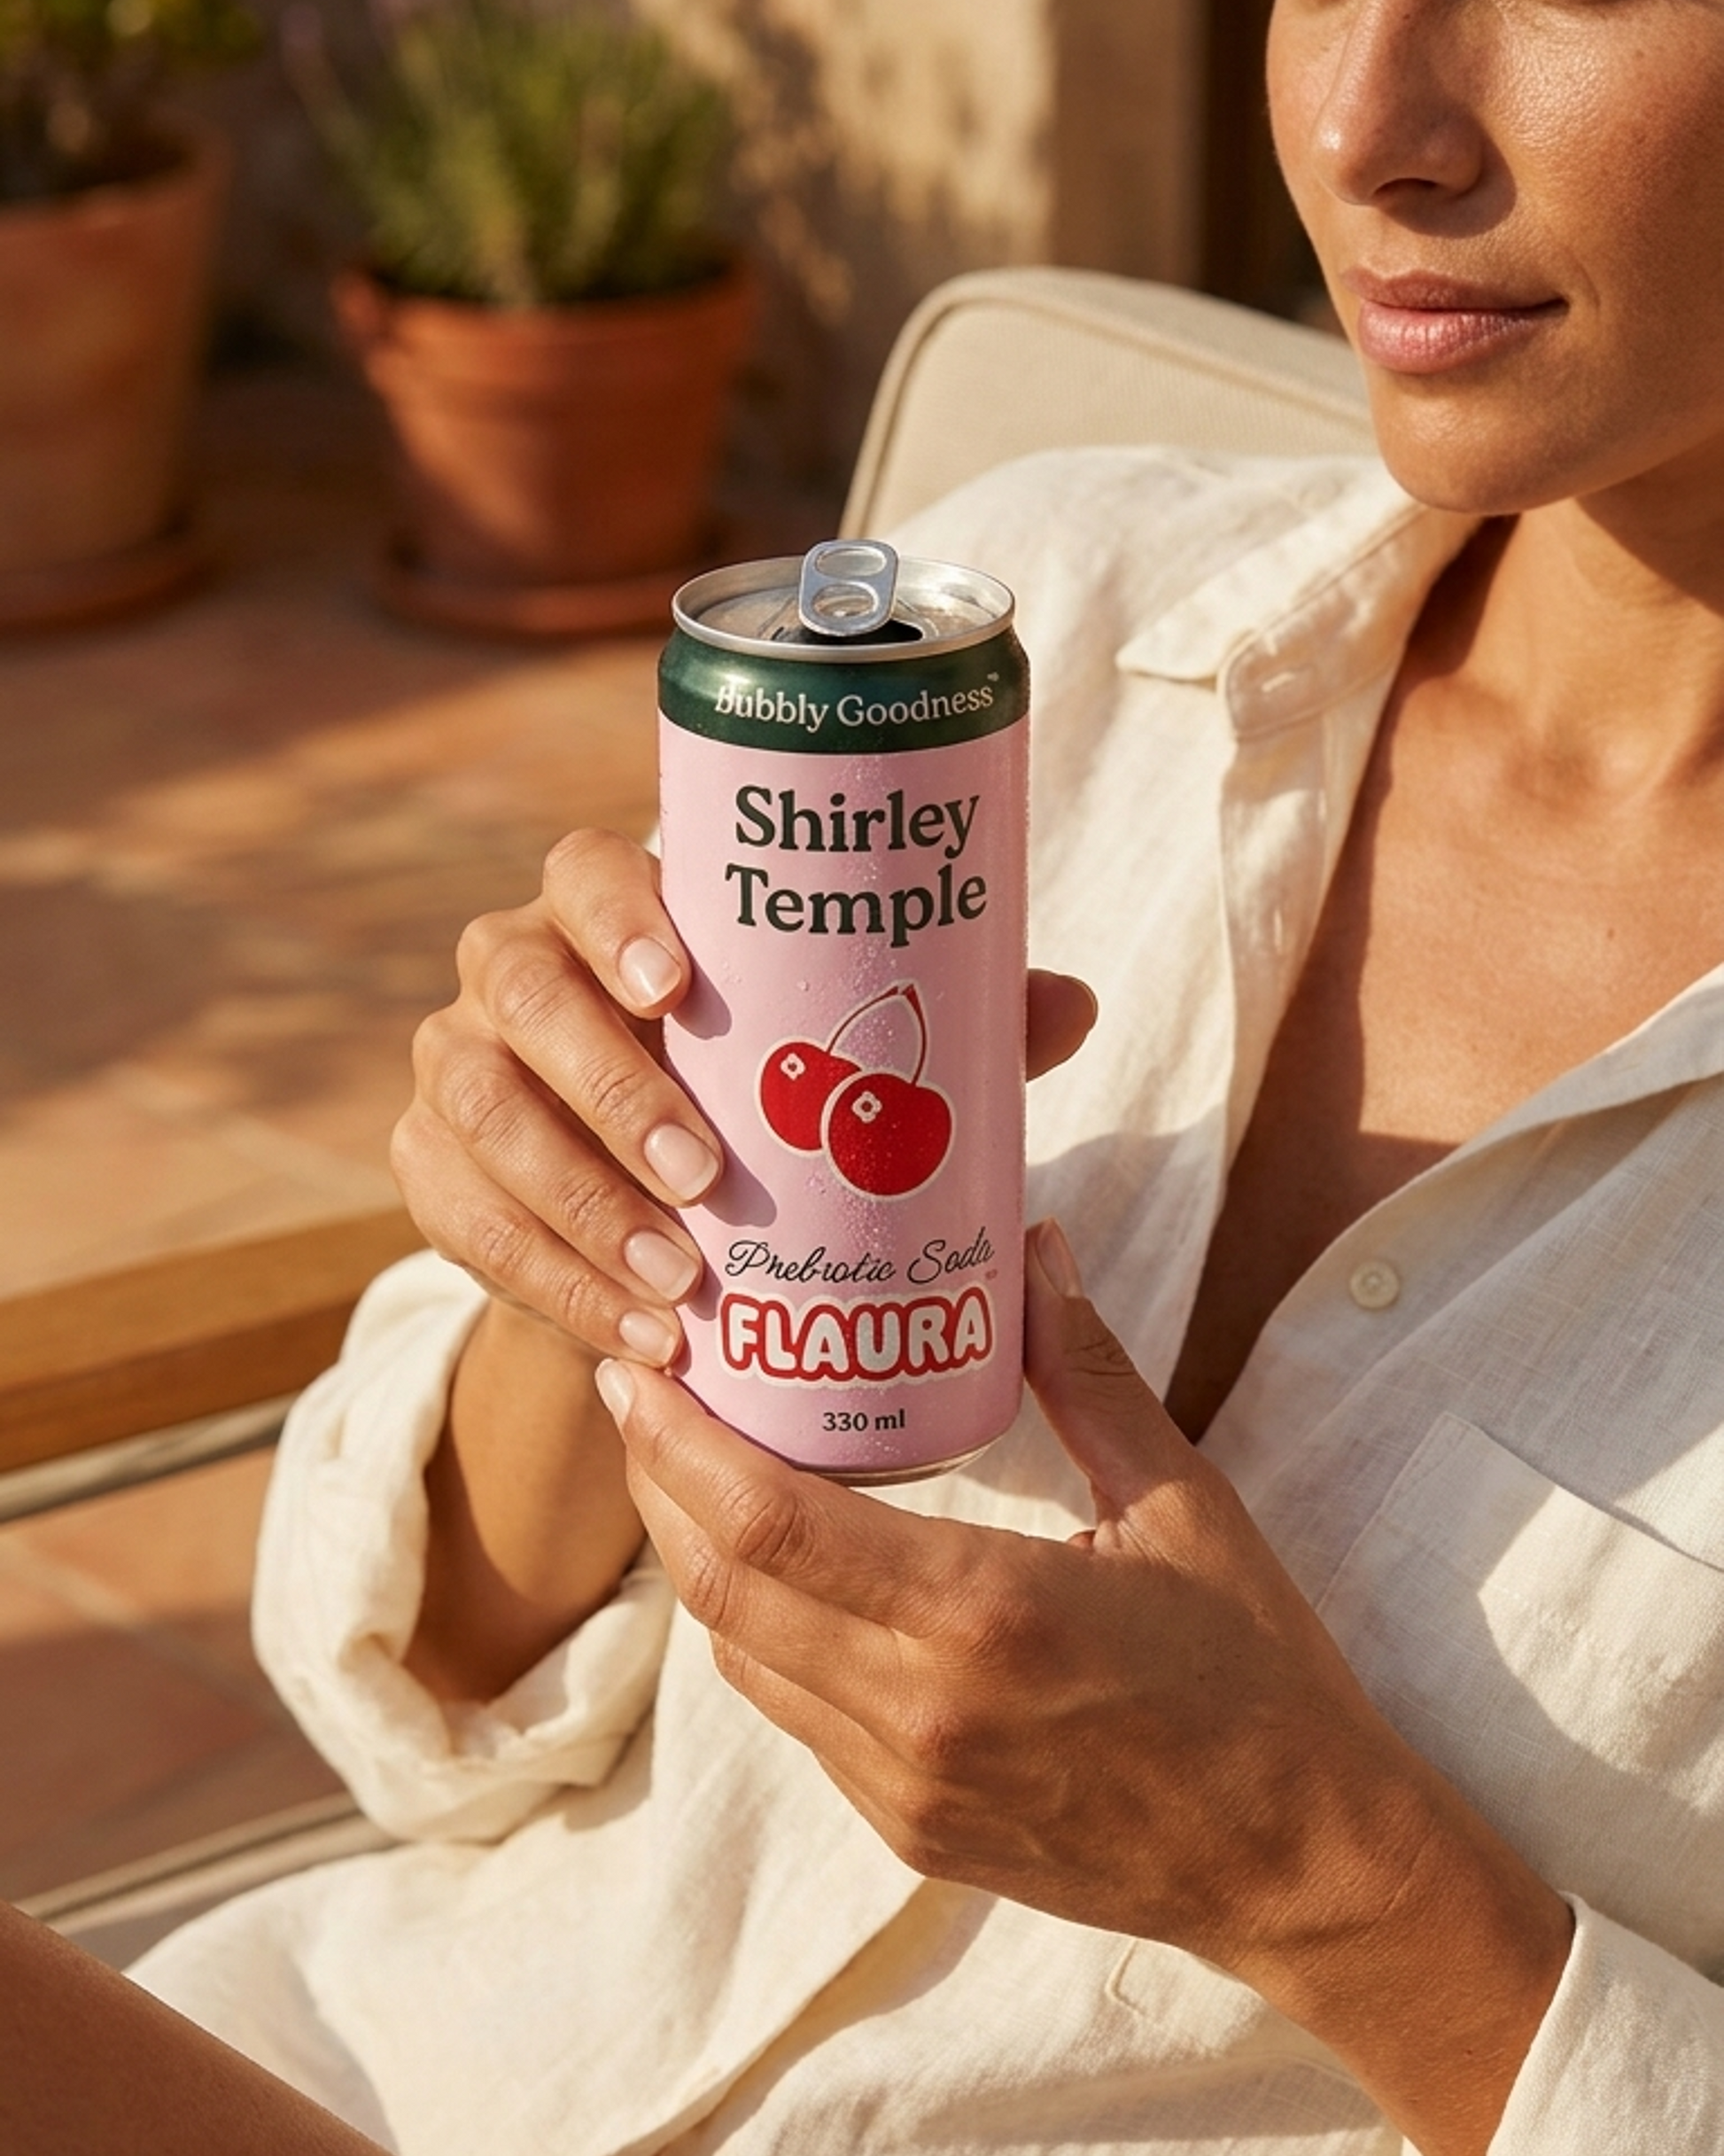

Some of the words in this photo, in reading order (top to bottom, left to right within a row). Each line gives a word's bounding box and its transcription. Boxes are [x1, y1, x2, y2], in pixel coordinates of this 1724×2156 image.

[716, 684, 828, 733] Bubbly
[837, 685, 993, 727] Goodness
[735, 784, 981, 860] Shirley
[725, 862, 988, 949] Temple
[906, 1226, 995, 1285] Soda
[721, 1287, 993, 1382] FLAURA
[822, 1411, 869, 1432] 330
[874, 1408, 905, 1431] ml
